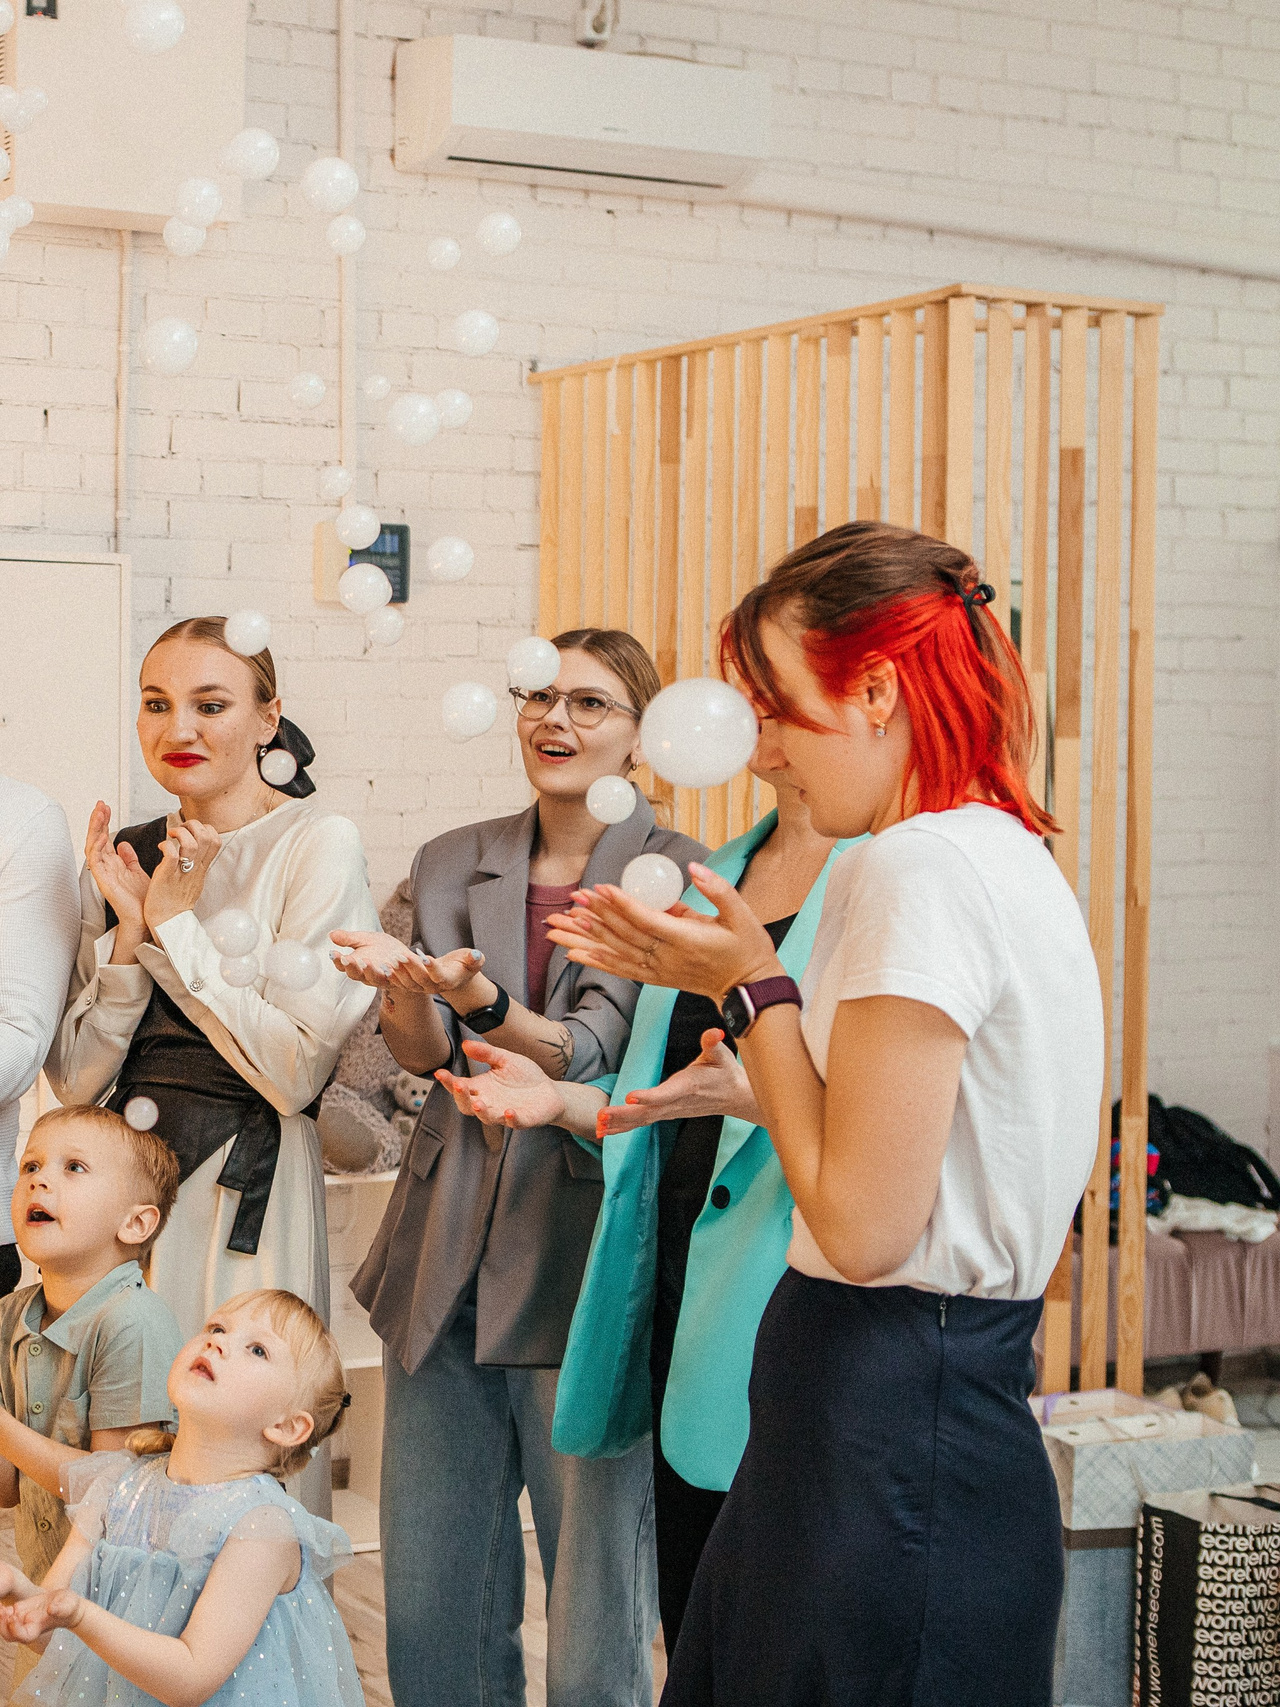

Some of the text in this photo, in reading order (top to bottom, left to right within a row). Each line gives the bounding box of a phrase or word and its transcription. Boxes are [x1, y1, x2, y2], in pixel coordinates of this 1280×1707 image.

[1199, 1533, 1255, 1551] ecret
[1197, 1564, 1252, 1582] ecret
[1196, 1597, 1250, 1614] ecret
[1194, 1628, 1247, 1646] ecret
[1193, 1660, 1245, 1677] ecret
[1190, 1690, 1242, 1707] ecret
